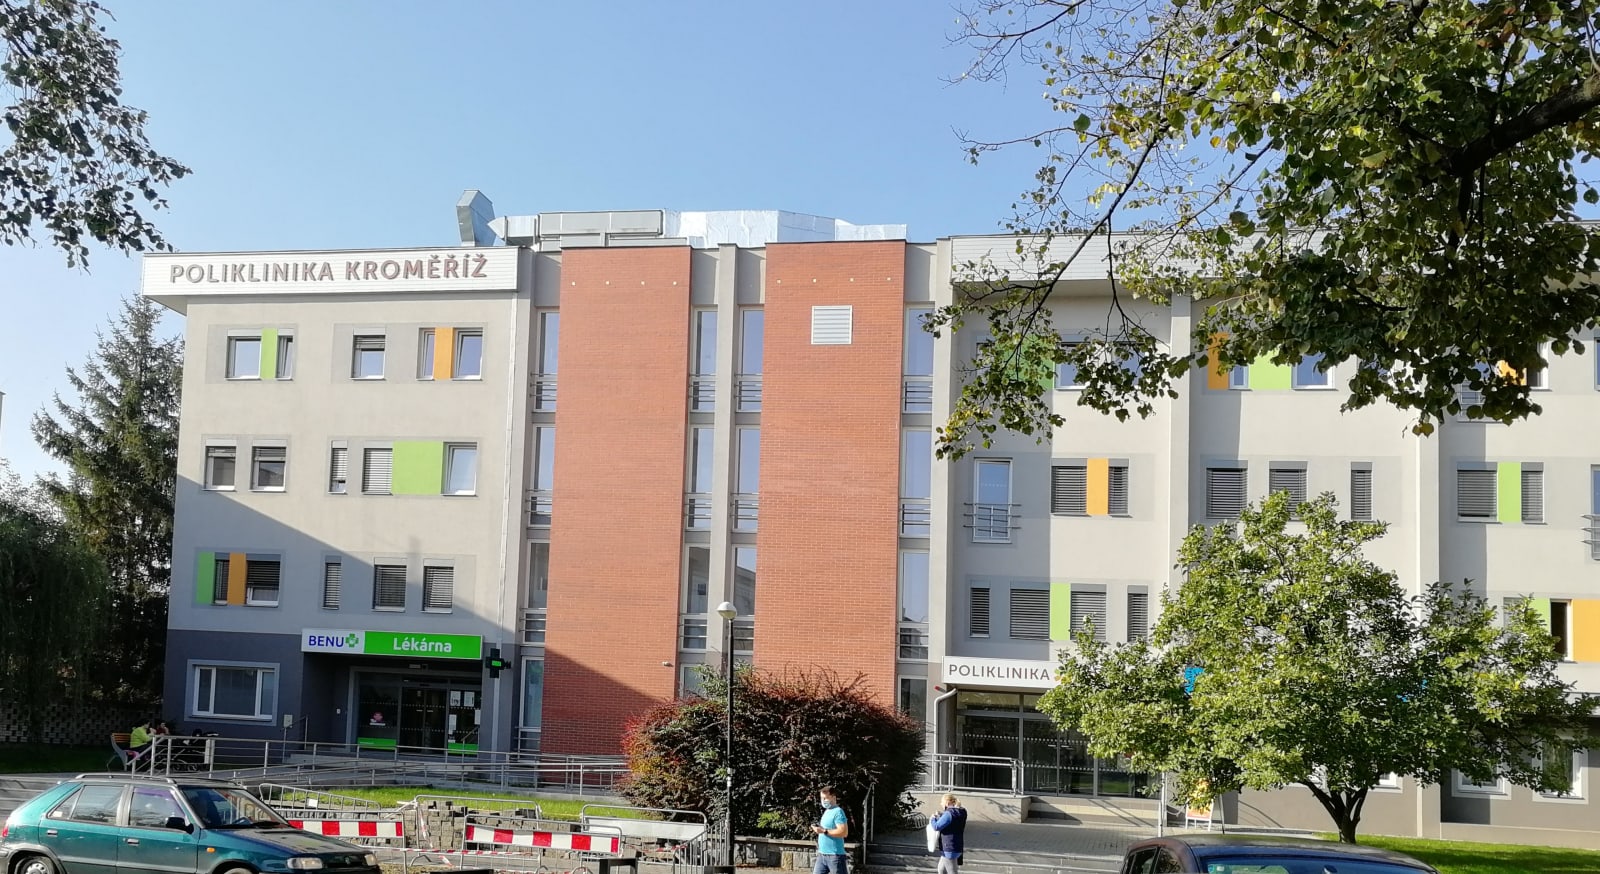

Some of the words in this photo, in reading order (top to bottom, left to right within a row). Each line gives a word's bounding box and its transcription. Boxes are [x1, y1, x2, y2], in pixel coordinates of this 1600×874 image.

[170, 260, 334, 284] POLIKLINIKA
[345, 253, 488, 280] KROMĚŘÍŽ
[308, 635, 344, 647] BENU
[393, 637, 452, 652] Lékárna
[949, 664, 1050, 681] POLIKLINIKA
